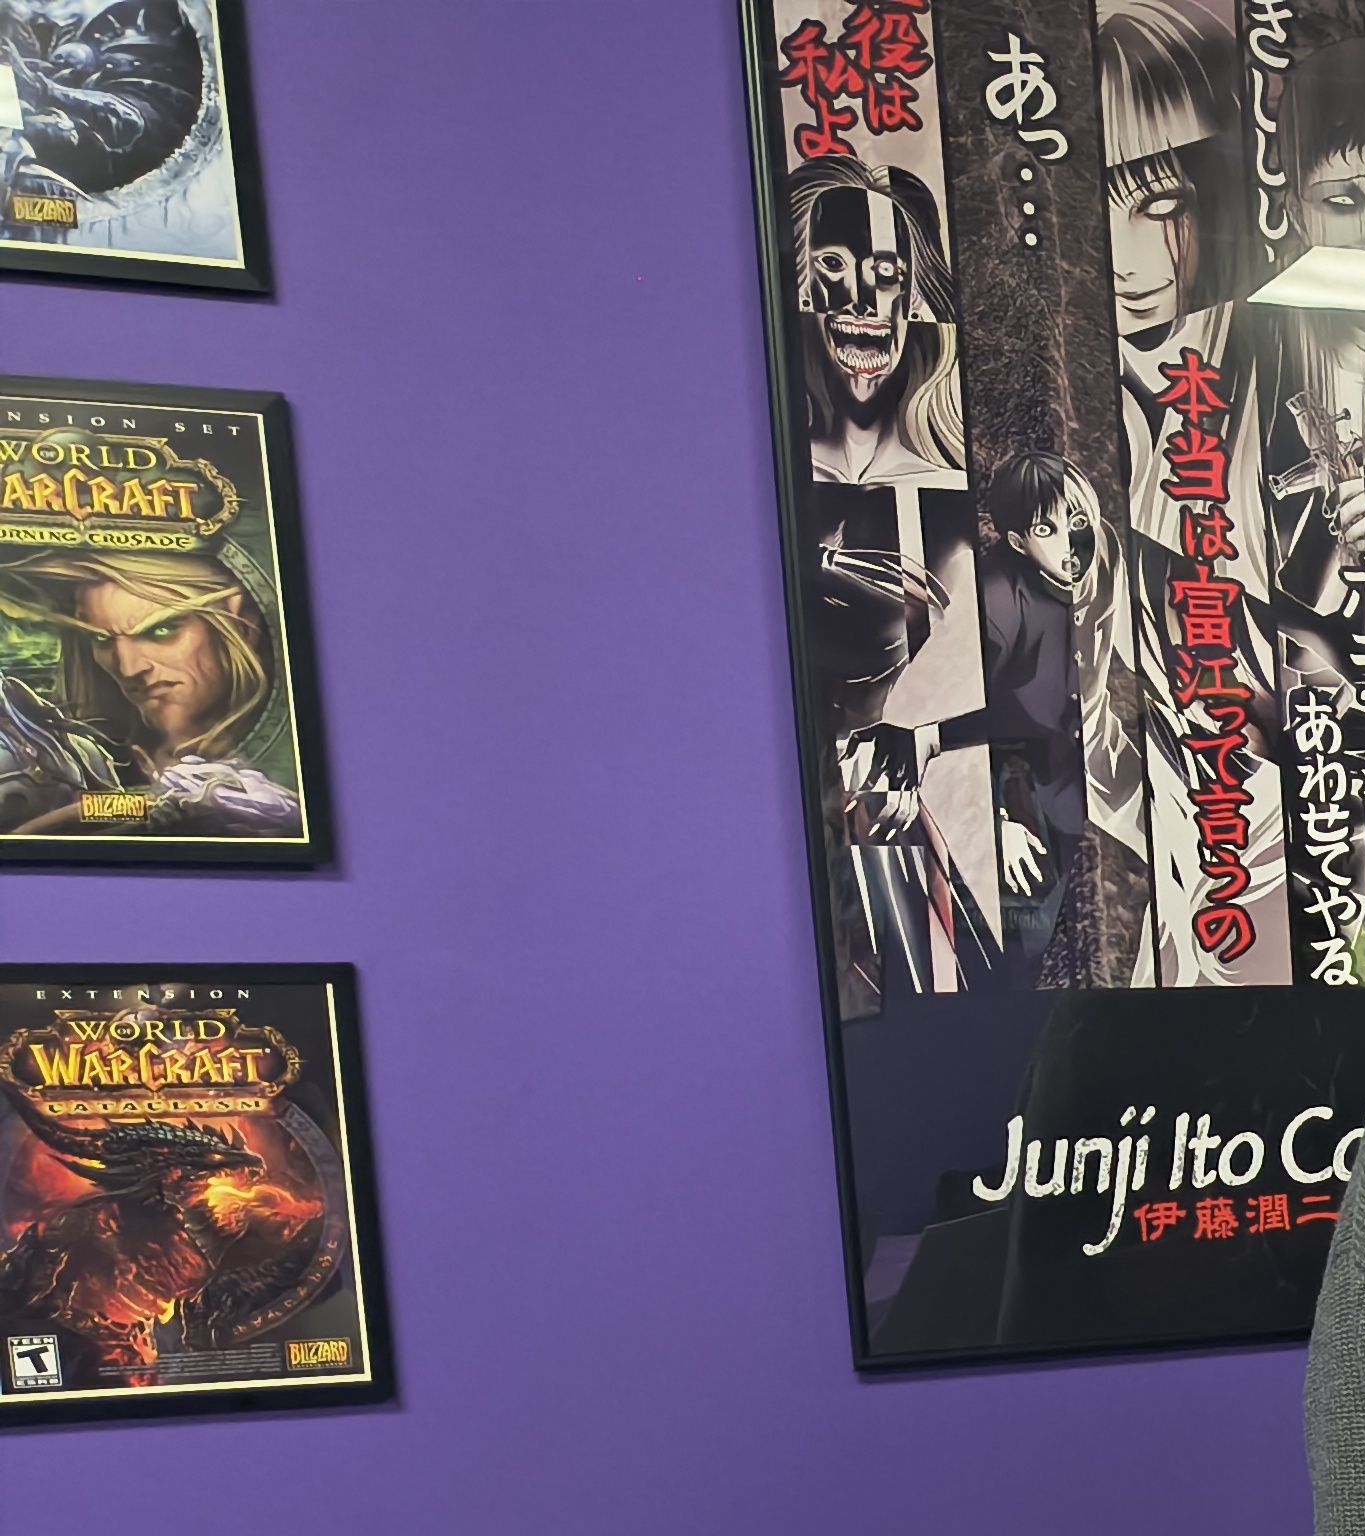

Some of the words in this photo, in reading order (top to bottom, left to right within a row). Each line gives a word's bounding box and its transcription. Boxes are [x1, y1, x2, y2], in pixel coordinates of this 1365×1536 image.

[848, 0, 927, 129] 役は
[783, 26, 864, 158] 私よ
[13, 197, 75, 222] BLIZZARD
[175, 422, 241, 437] SET
[0, 441, 158, 471] WORLD
[0, 467, 199, 522] ARCRAFT
[88, 532, 193, 550] CRUSADE
[1157, 354, 1254, 961] 本当は富江って言うの
[82, 793, 146, 818] BLIZZARD
[1295, 696, 1361, 987] あわせてやる
[36, 988, 250, 1000] EXTENSION
[67, 1019, 227, 1044] WORLD
[29, 1042, 264, 1092] WARCRAFT
[48, 1100, 262, 1113] CATACLYSM
[971, 1105, 1157, 1258] Junji
[1168, 1112, 1266, 1190] Ito
[1133, 1193, 1342, 1243] 伊藤潤二
[11, 1337, 53, 1346] TEEN
[289, 1342, 349, 1366] BLIZZARD
[16, 1345, 50, 1374] T
